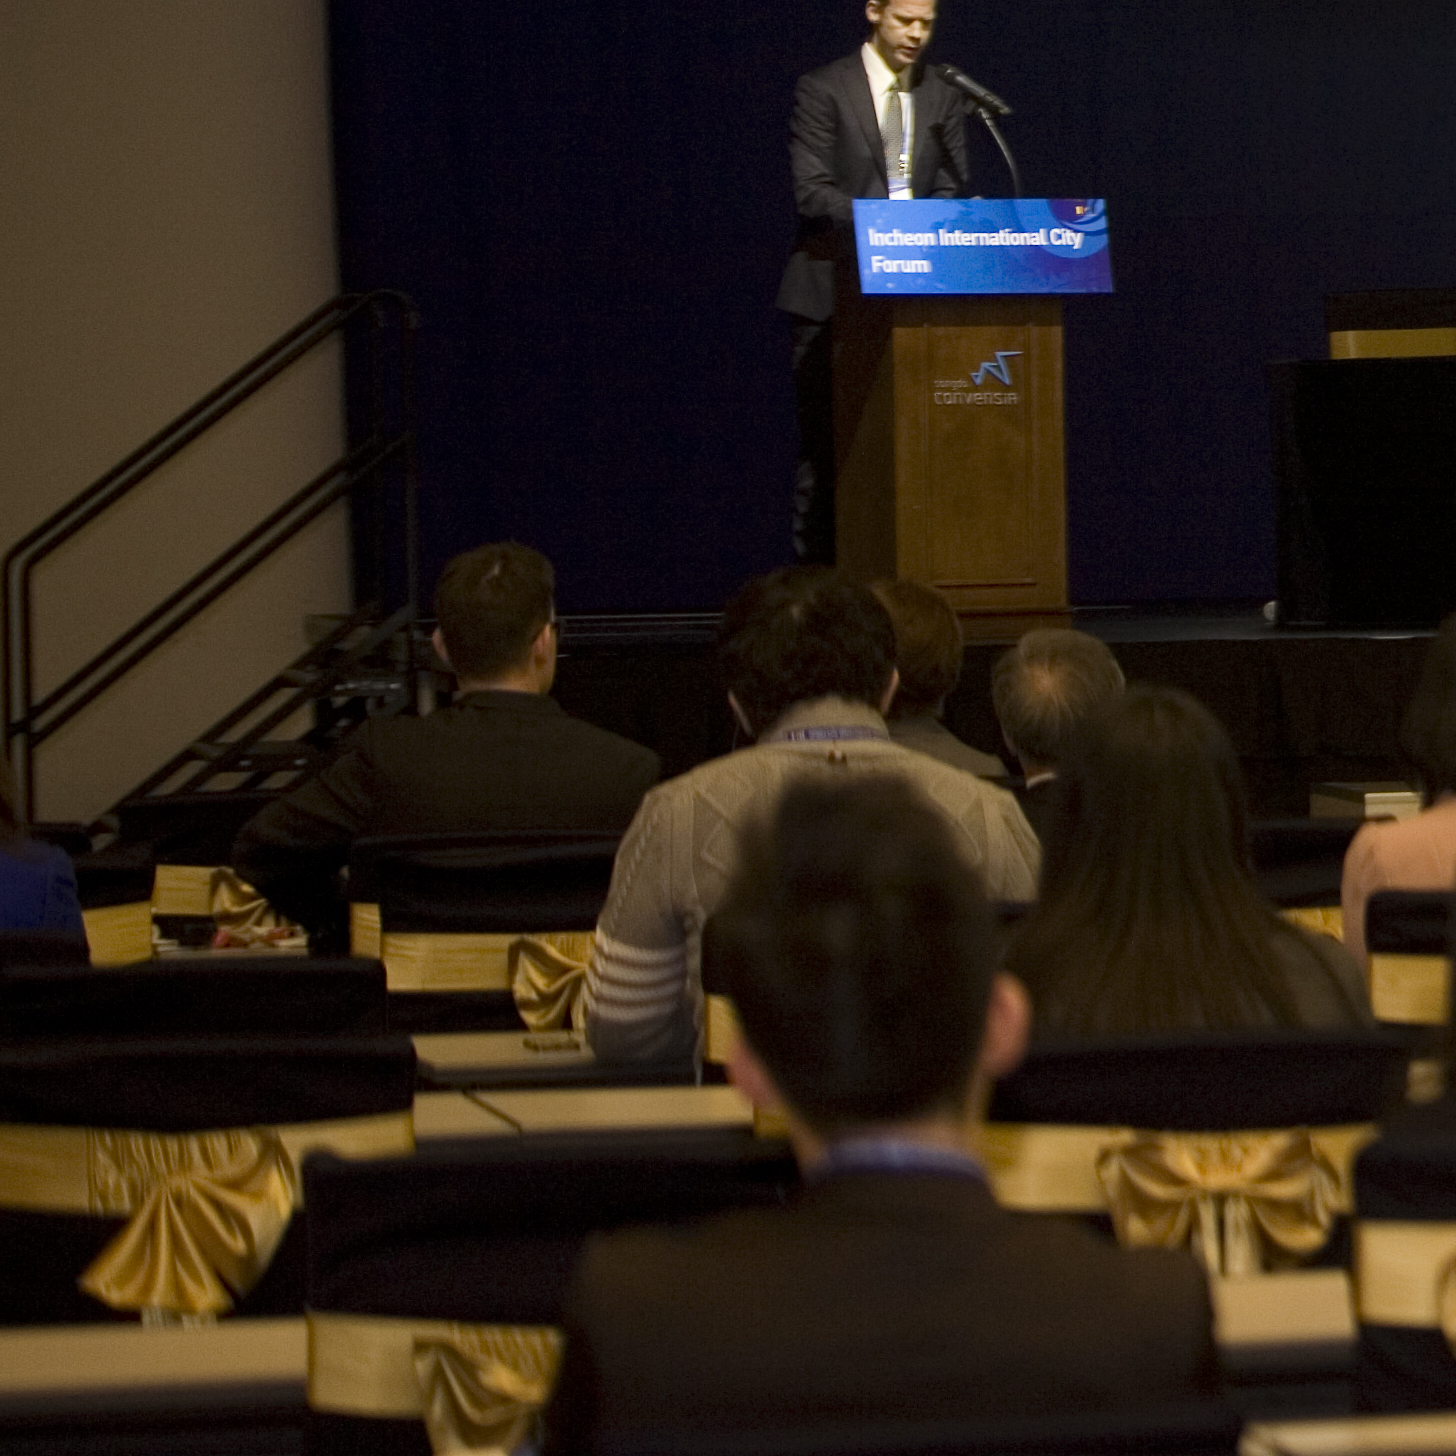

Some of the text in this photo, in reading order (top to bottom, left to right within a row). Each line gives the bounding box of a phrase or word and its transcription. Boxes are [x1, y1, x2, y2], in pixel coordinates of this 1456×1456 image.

[868, 228, 1085, 250] Incheon International City
[871, 255, 932, 273] Forum
